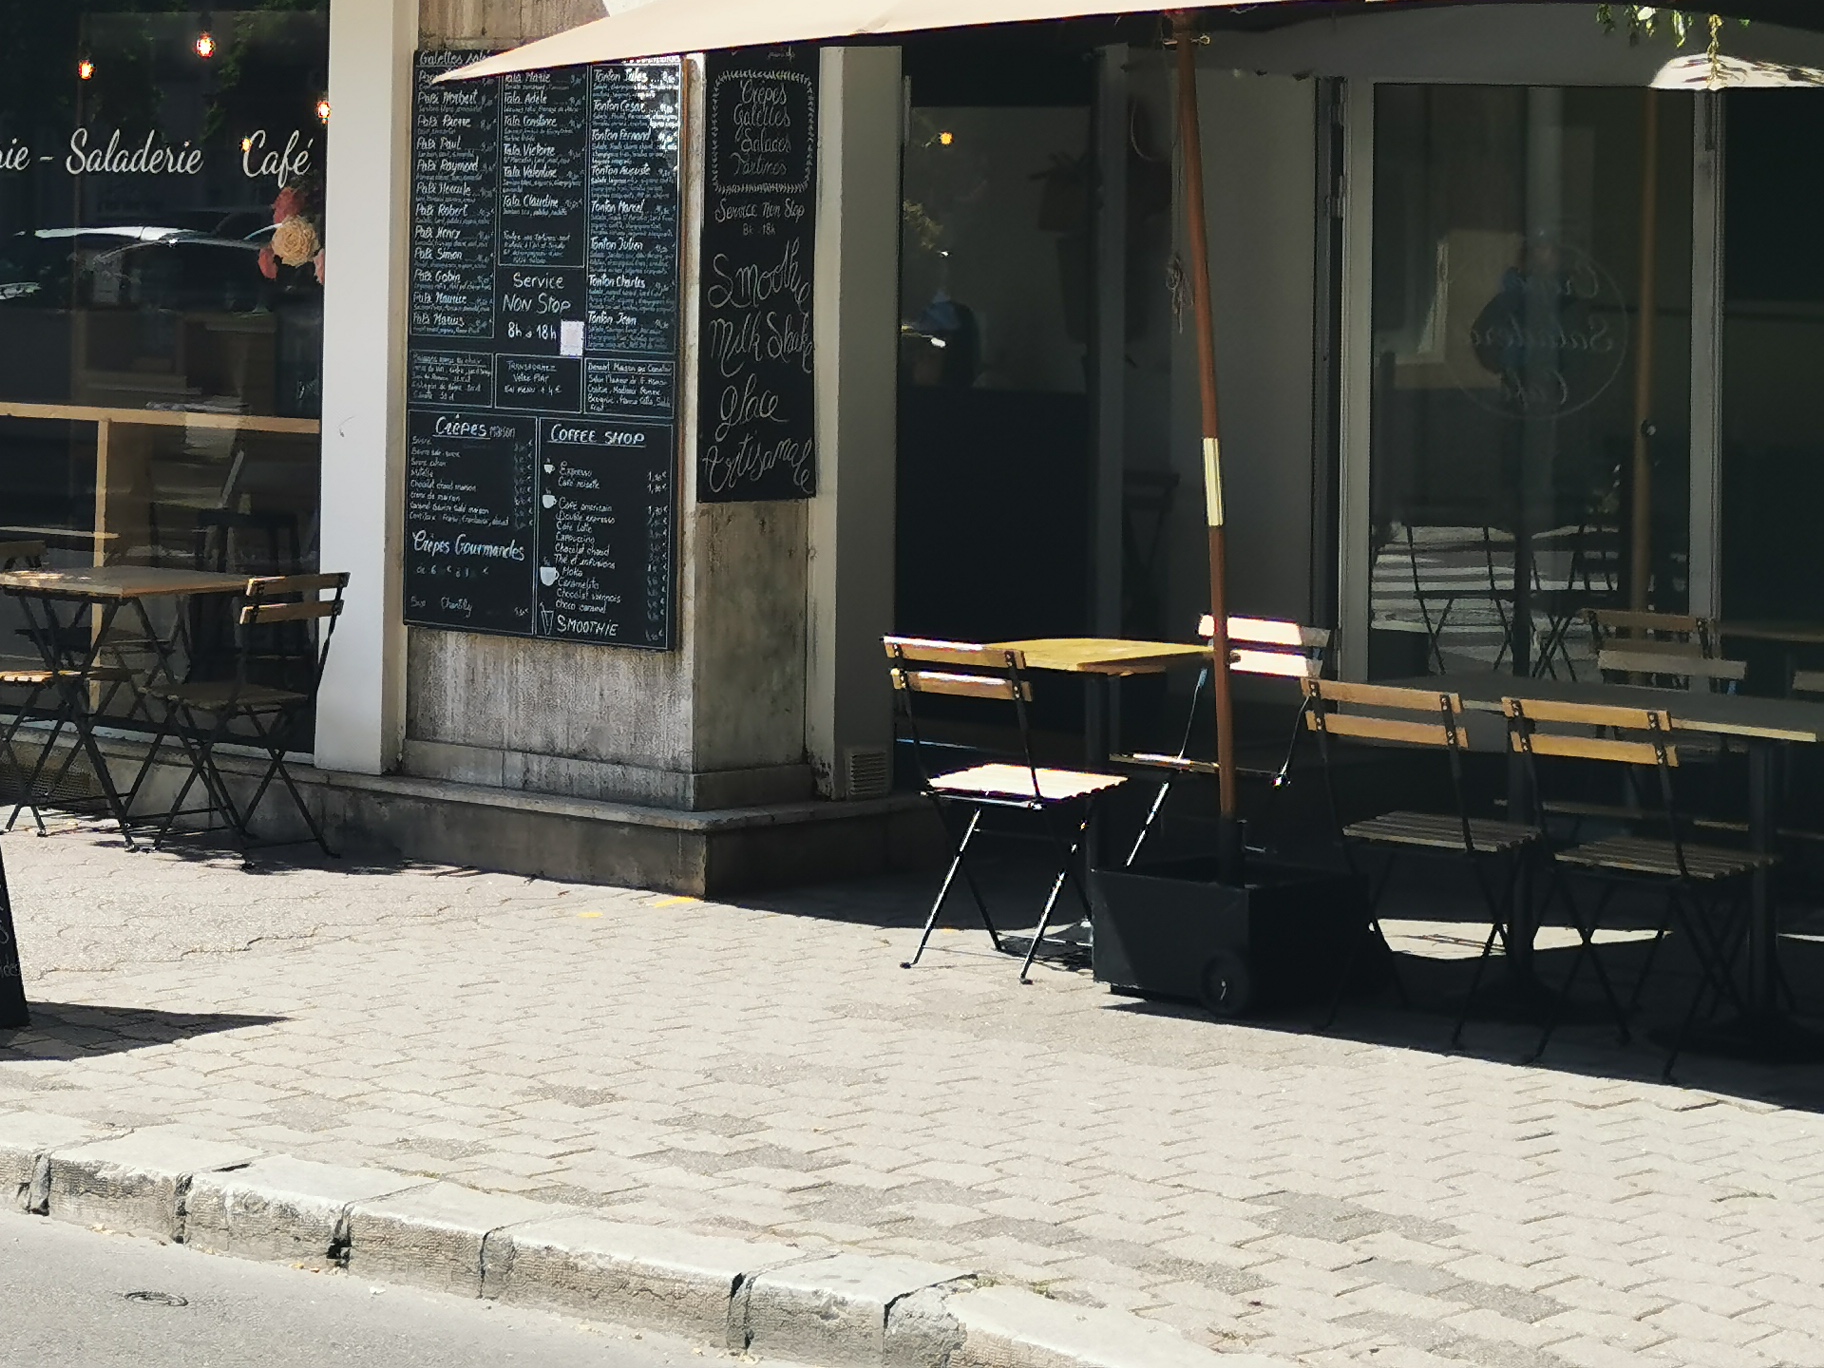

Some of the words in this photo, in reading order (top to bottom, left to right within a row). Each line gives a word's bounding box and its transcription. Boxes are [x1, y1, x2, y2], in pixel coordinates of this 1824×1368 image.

[65, 128, 204, 177] Saladerie
[242, 129, 315, 187] Café
[714, 196, 758, 223] Service
[512, 272, 565, 289] Service
[708, 310, 763, 378] Milk
[604, 430, 646, 445] SHOP
[454, 533, 526, 562] Gourmandes
